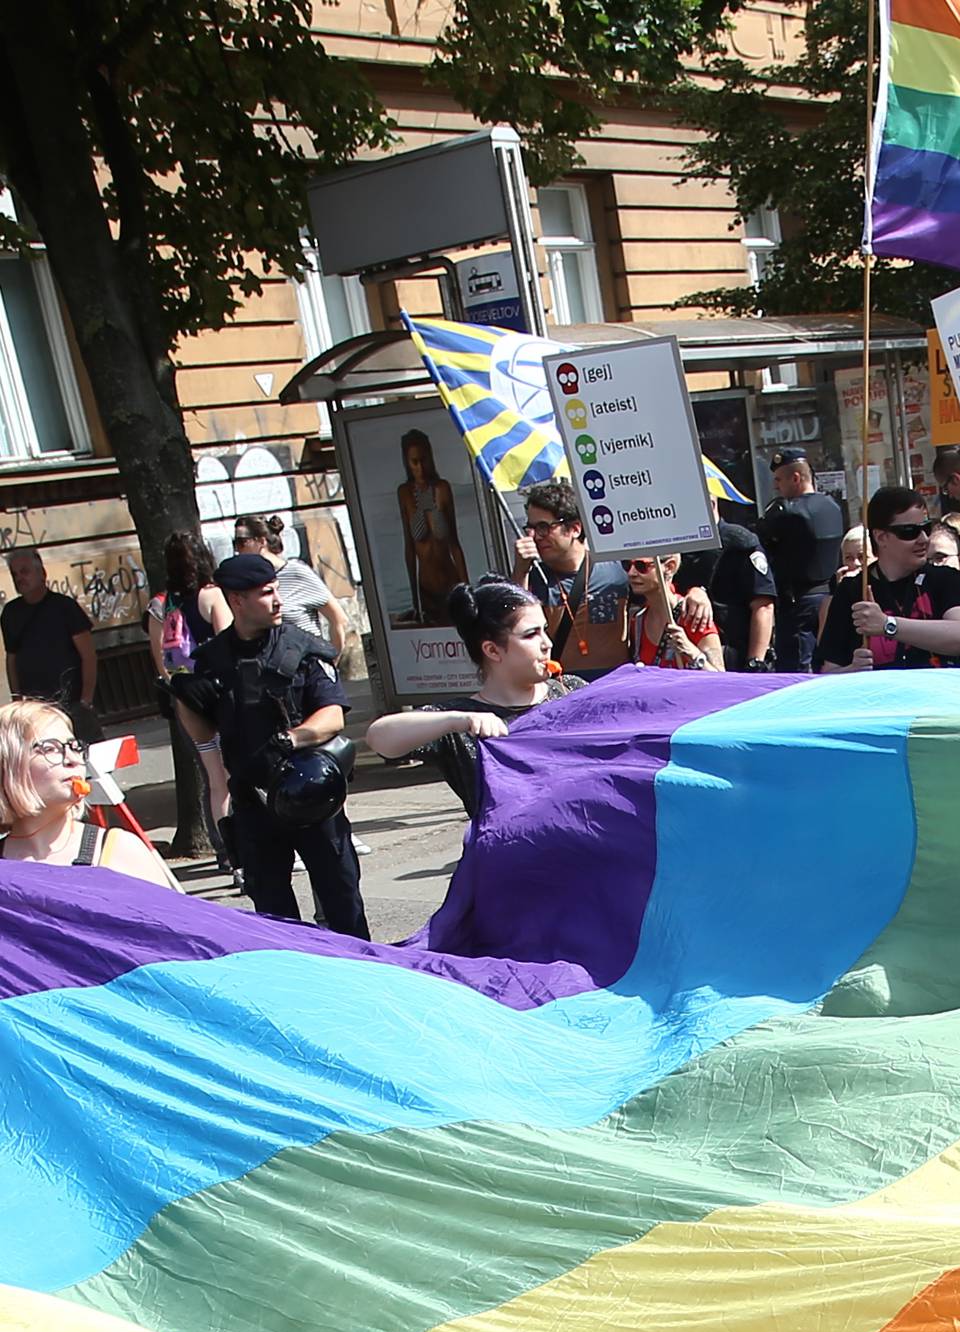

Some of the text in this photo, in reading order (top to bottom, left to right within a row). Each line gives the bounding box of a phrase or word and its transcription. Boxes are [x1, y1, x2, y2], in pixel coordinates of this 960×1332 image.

[582, 363, 613, 383] [gej]
[590, 396, 638, 418] [ateist]
[599, 432, 654, 455] [vjernik]
[608, 470, 652, 489] [strejt]
[616, 503, 677, 525] [nebitno]
